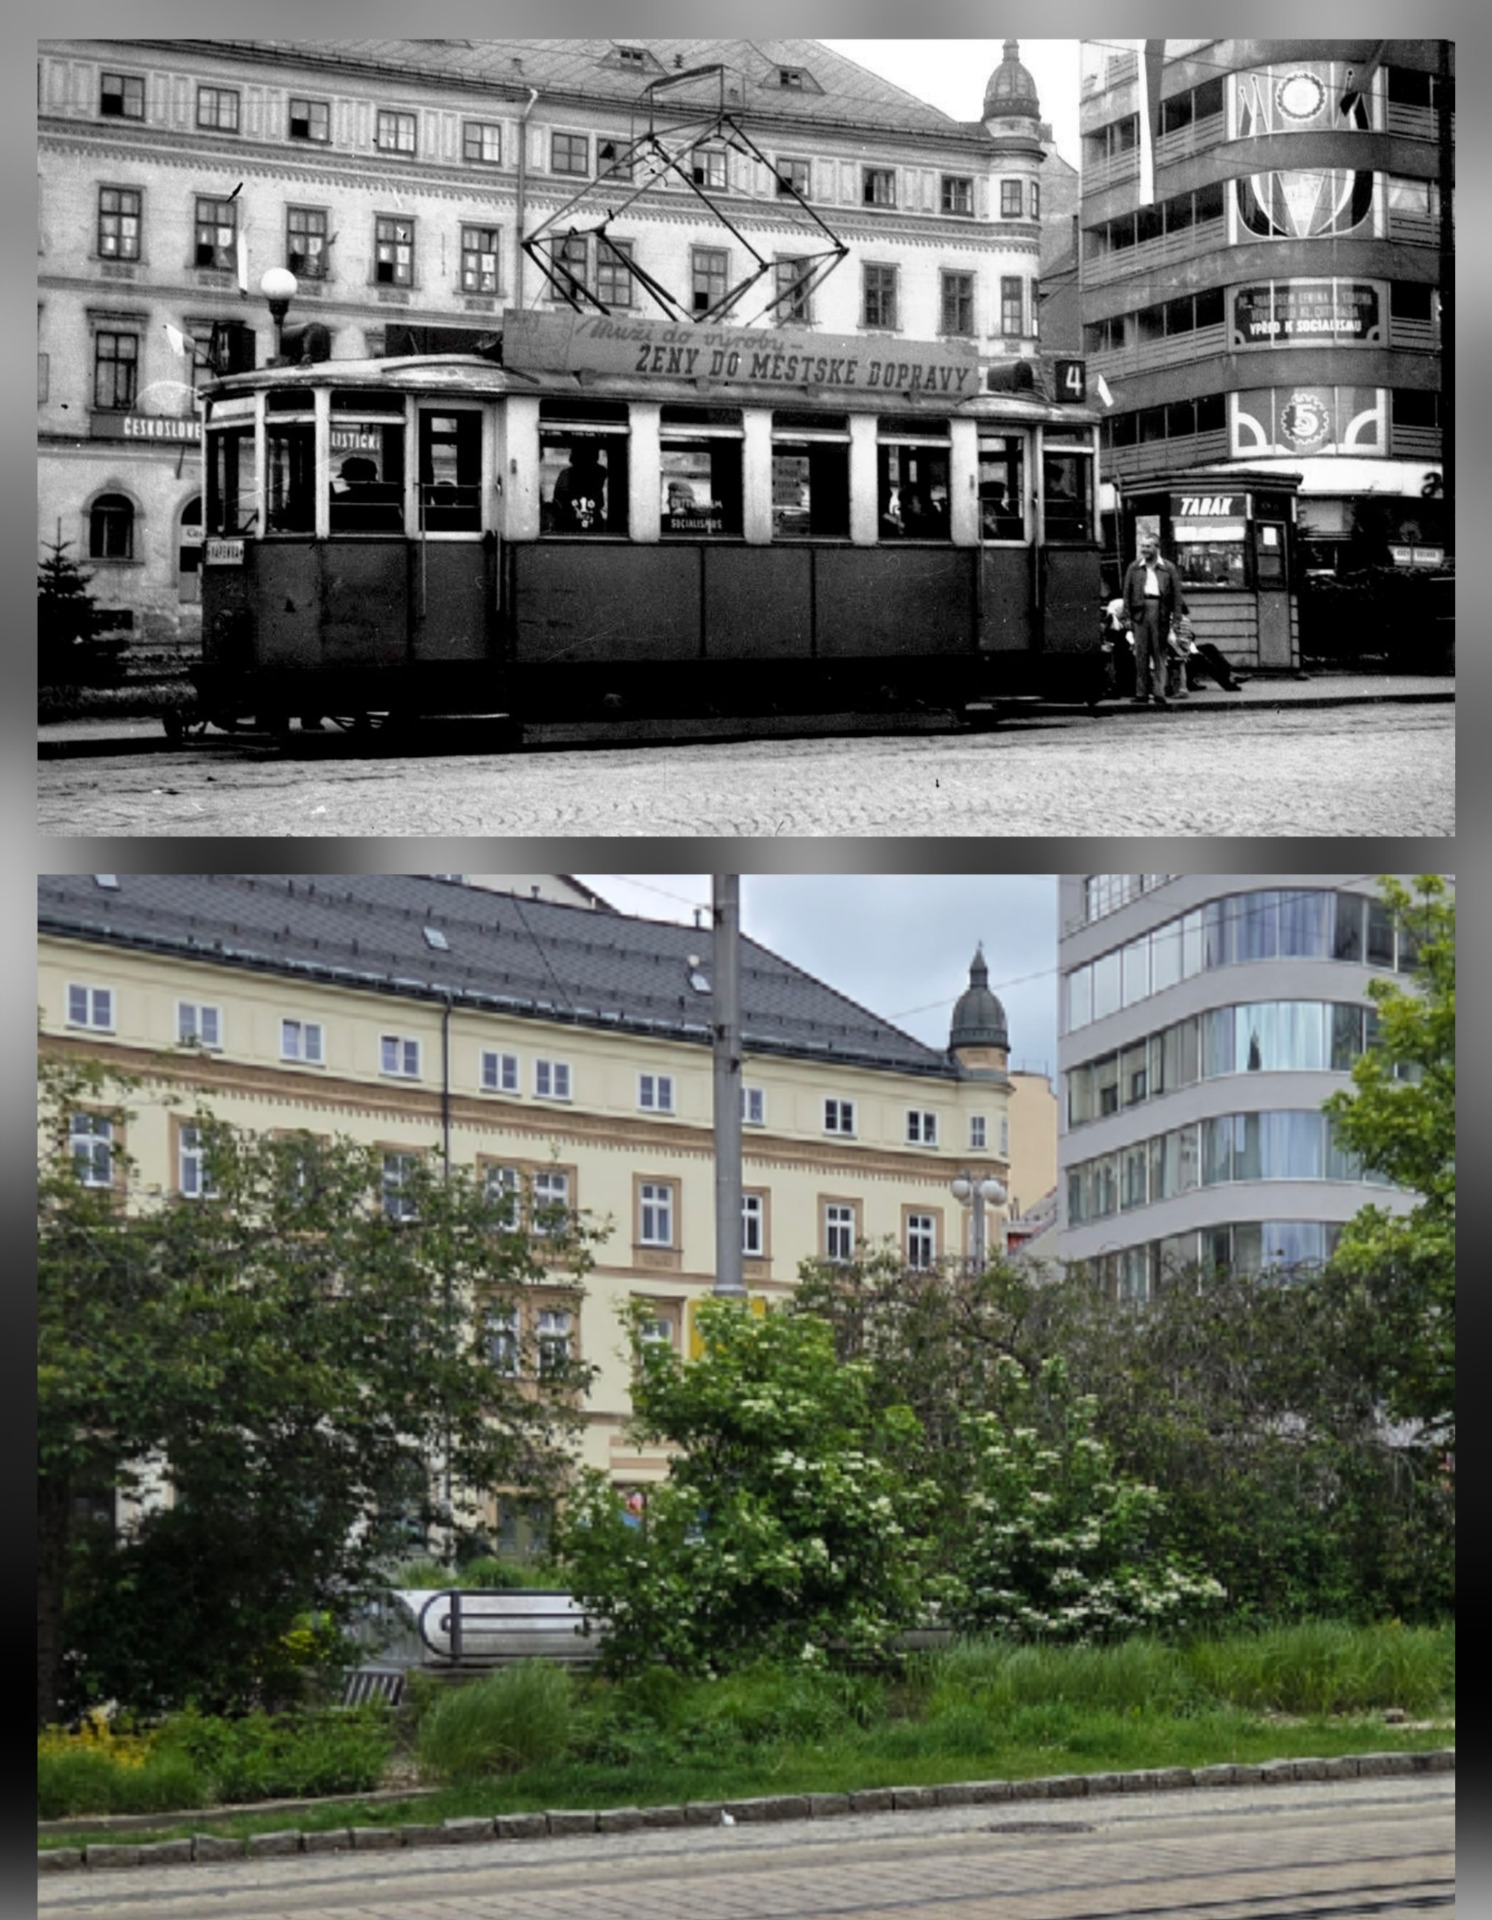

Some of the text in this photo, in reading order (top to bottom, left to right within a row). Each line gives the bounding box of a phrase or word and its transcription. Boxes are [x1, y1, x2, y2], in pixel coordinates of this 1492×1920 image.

[663, 325, 694, 344] do
[1284, 320, 1294, 333] K
[1296, 319, 1361, 333] SOCIALISMU
[635, 341, 700, 374] ŽENY
[709, 349, 740, 377] DO
[867, 361, 970, 392] DOPRAVY
[1066, 366, 1082, 396] 4
